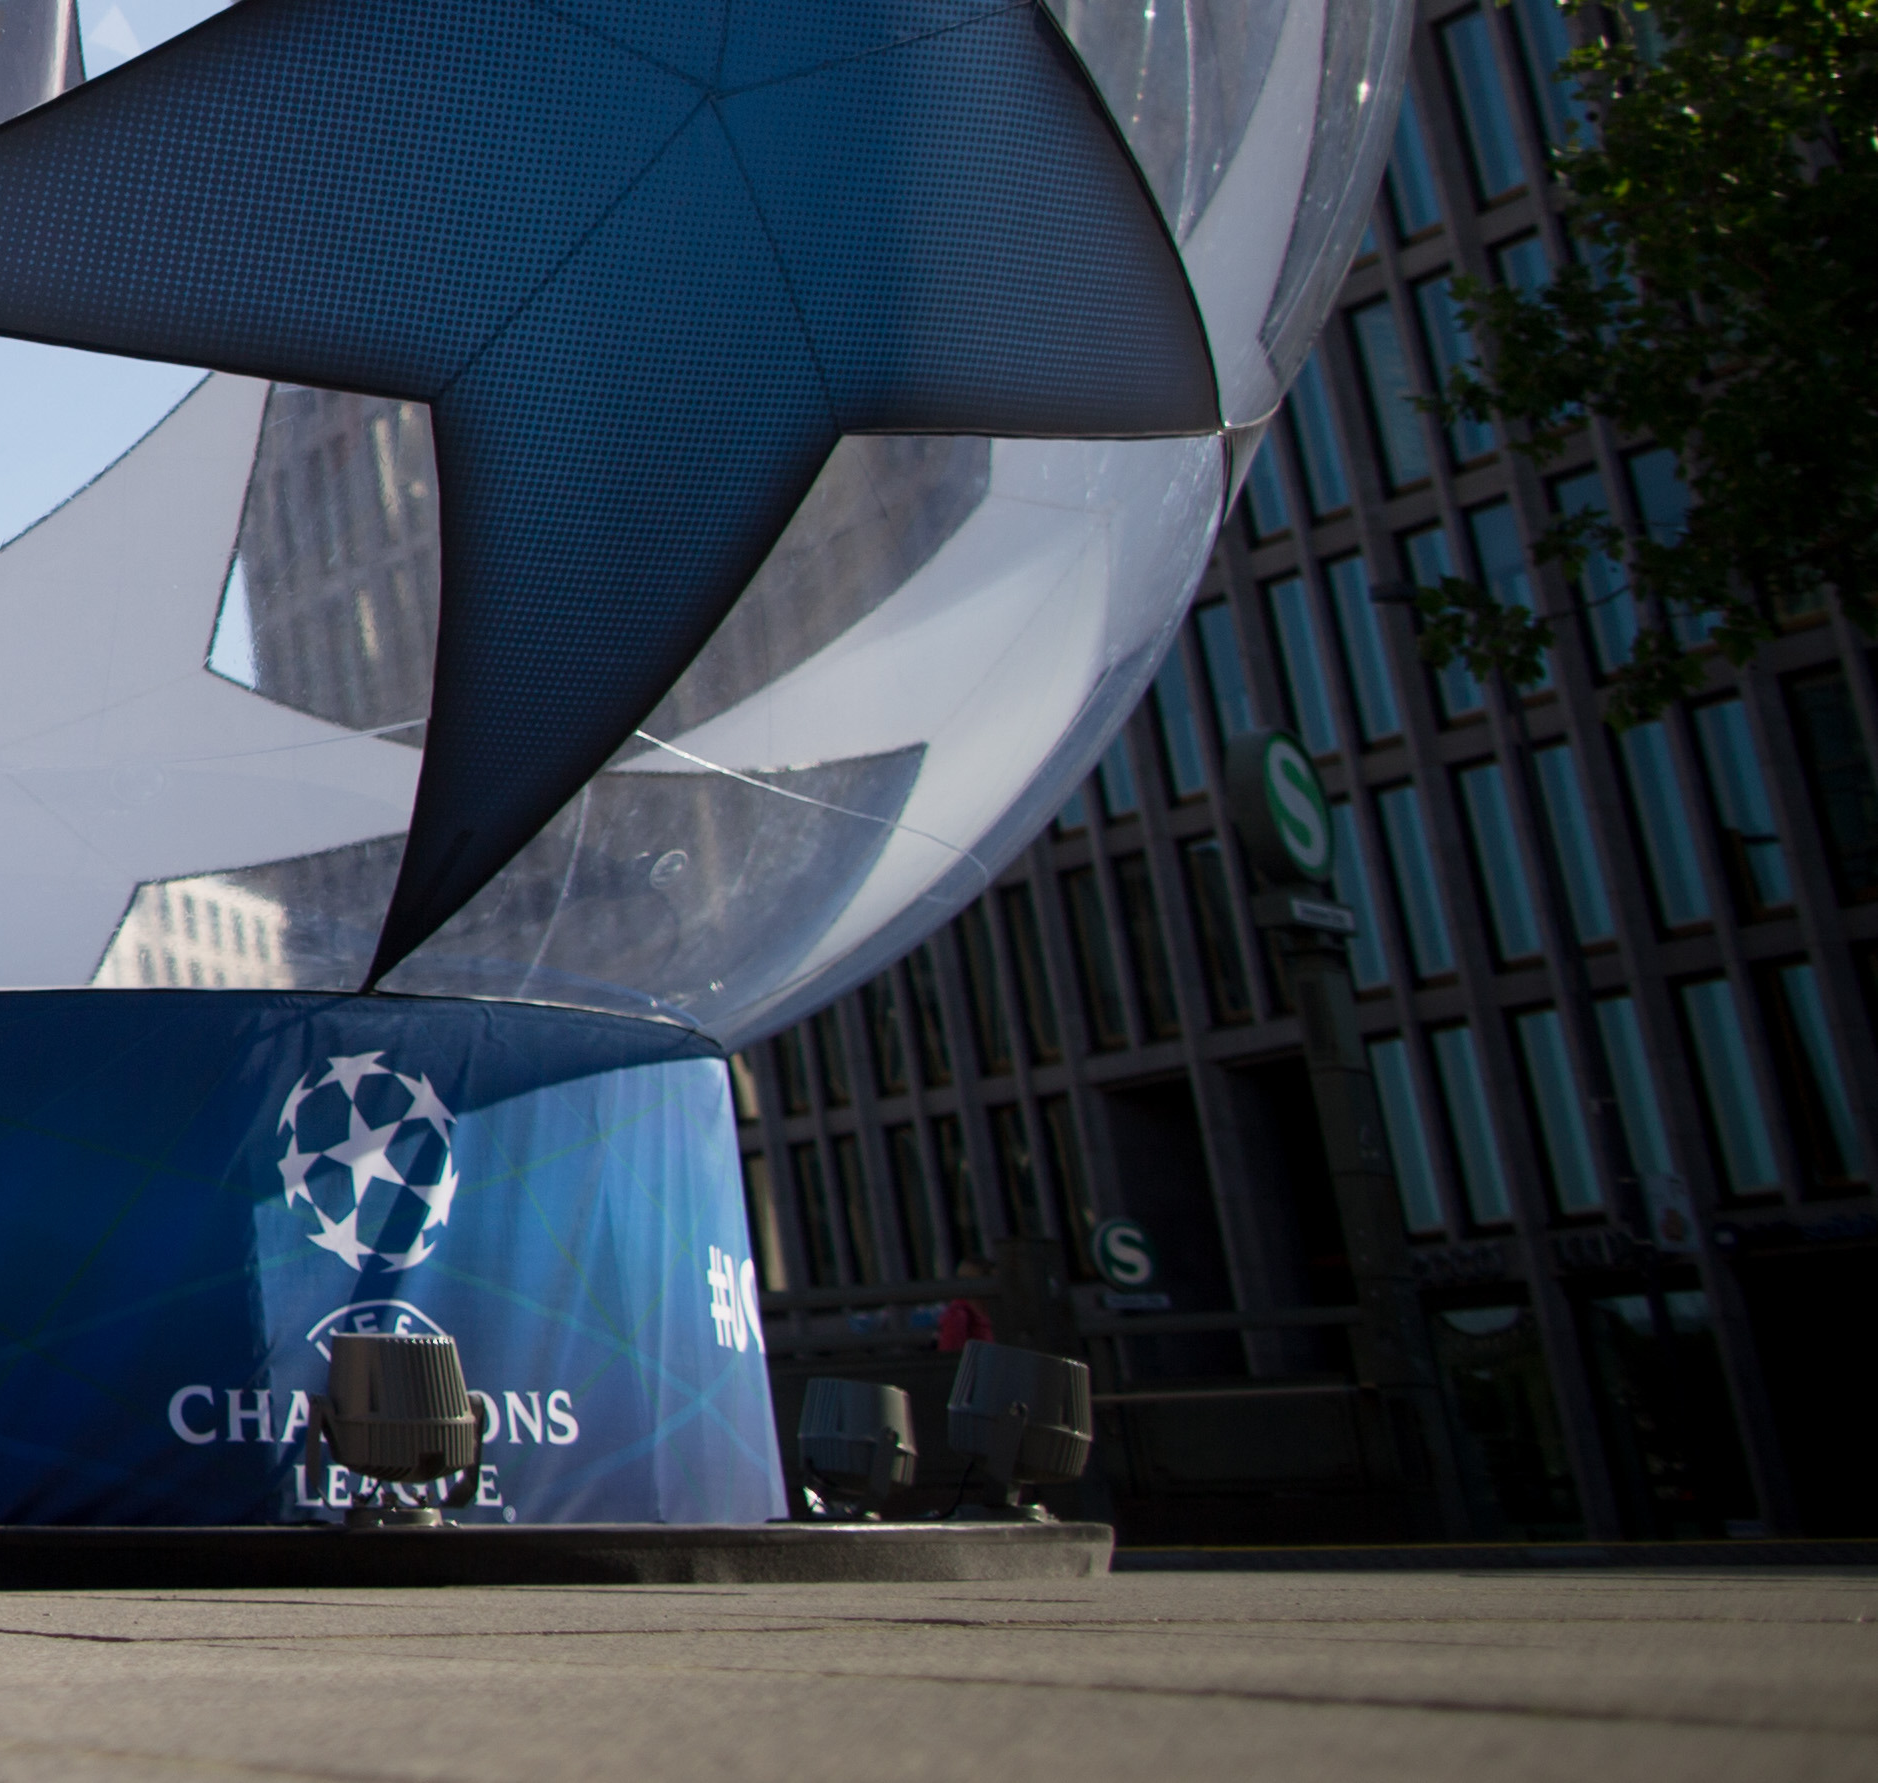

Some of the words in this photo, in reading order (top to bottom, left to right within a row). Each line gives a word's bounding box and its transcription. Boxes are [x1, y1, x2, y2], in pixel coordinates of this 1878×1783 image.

[1268, 740, 1327, 868] S
[1106, 1225, 1152, 1285] S
[166, 1384, 580, 1445] CHANS
